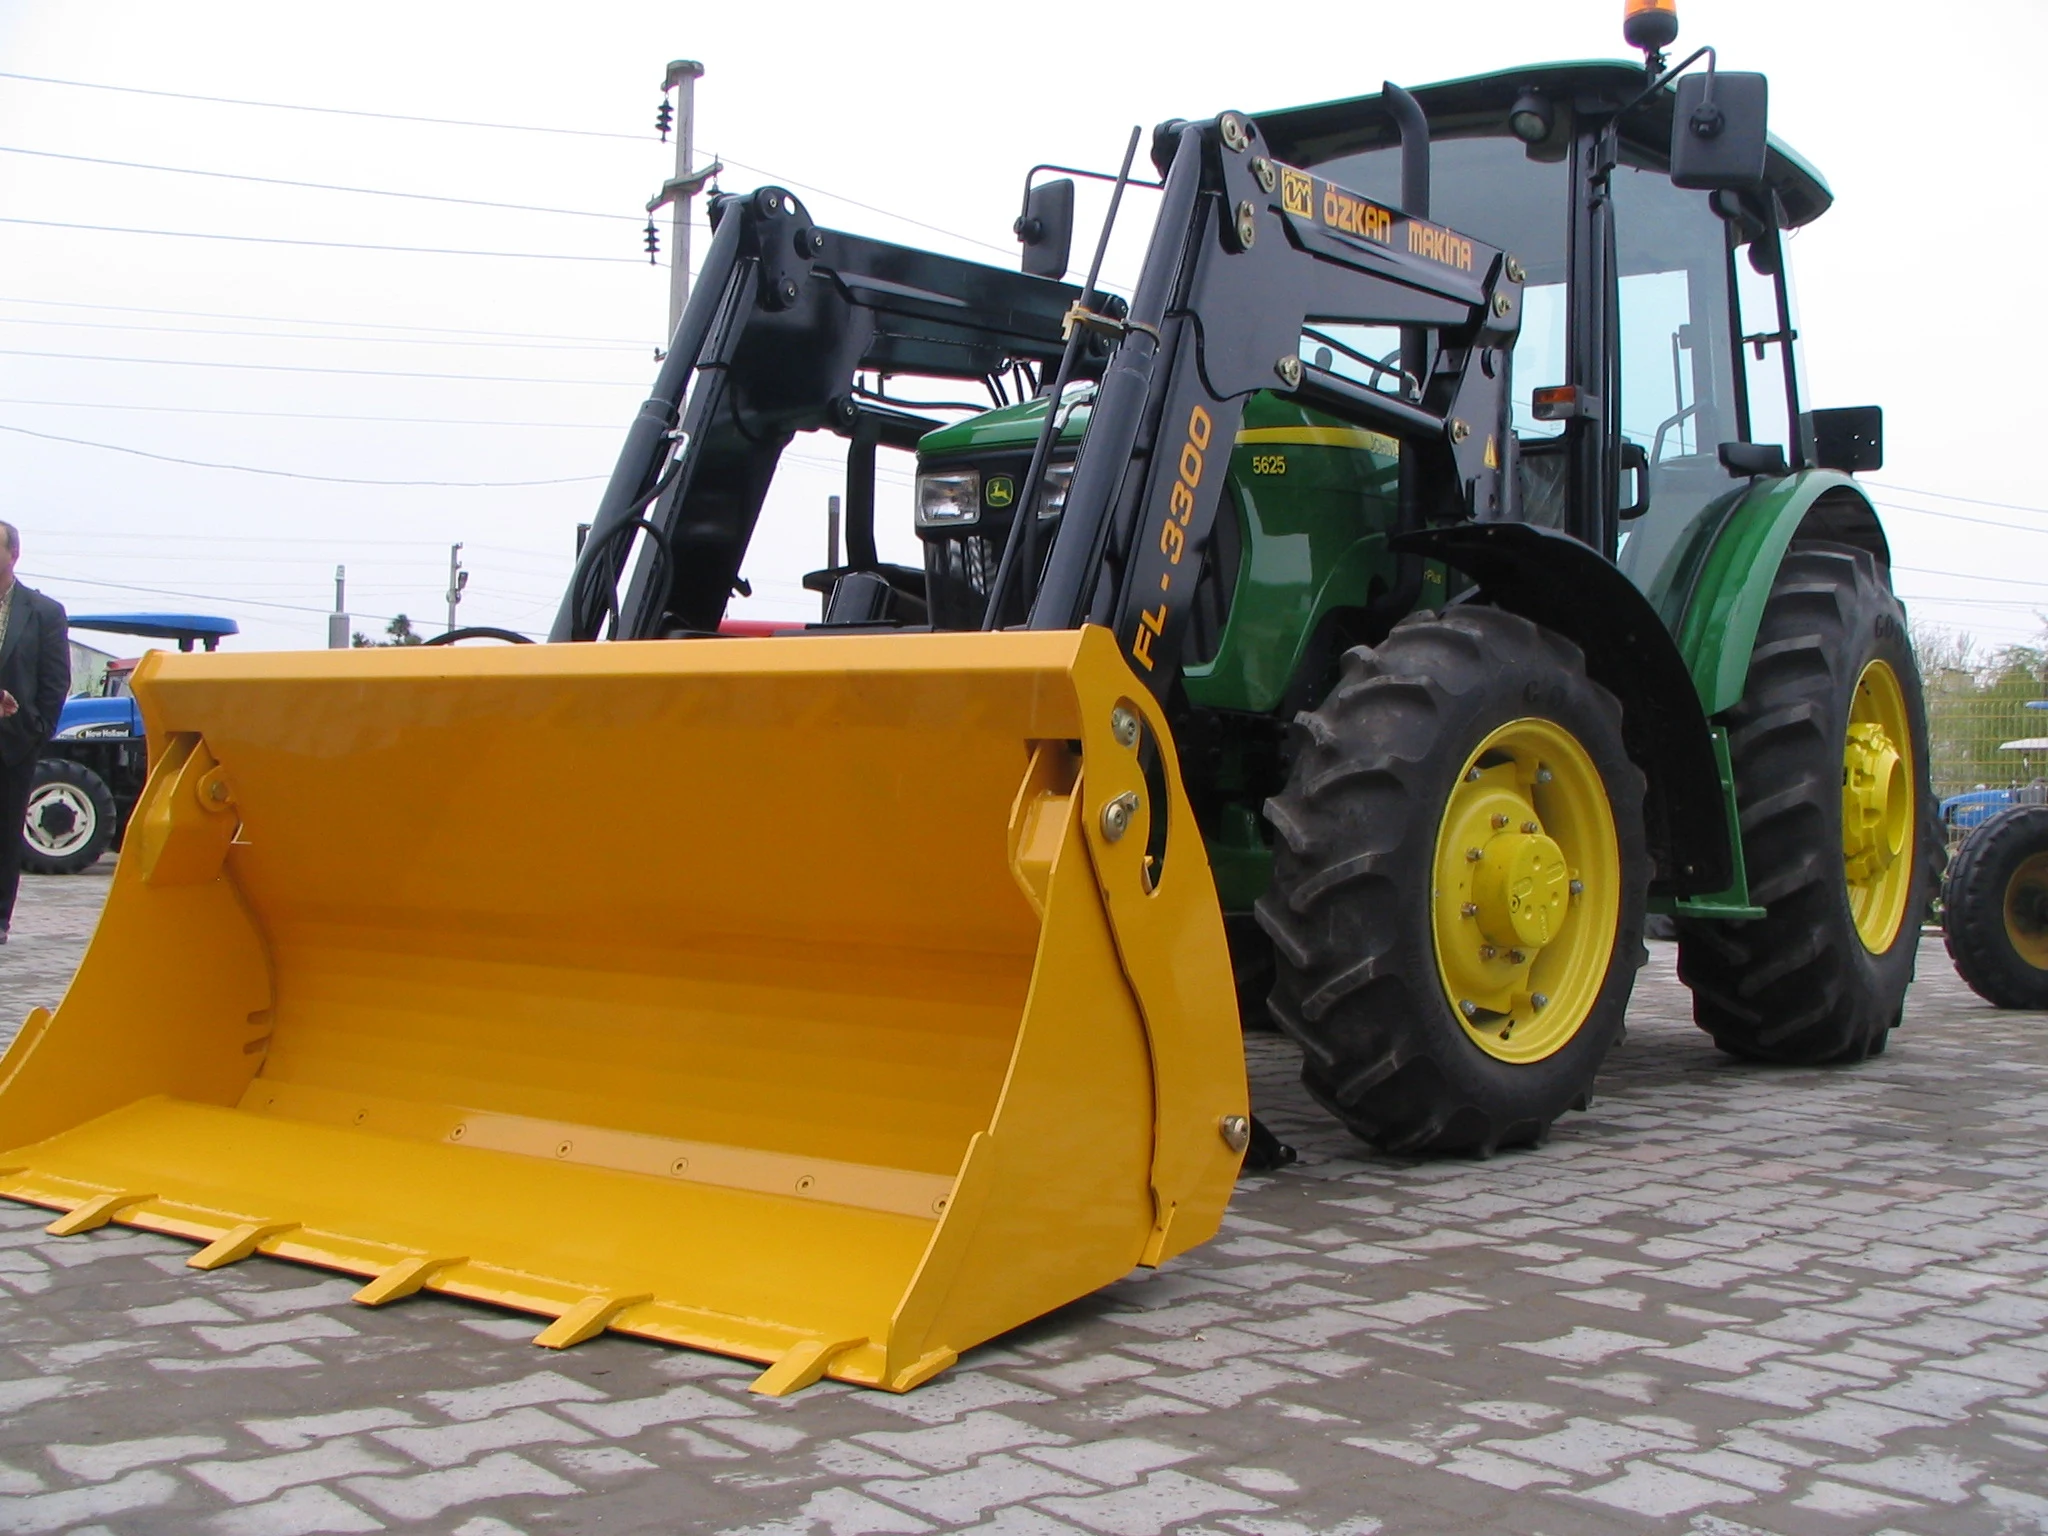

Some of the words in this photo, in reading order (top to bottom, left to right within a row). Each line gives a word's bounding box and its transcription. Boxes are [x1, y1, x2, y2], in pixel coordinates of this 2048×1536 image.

[1323, 184, 1391, 244] ÖZKAN
[1252, 455, 1286, 475] 5625
[1133, 604, 1167, 672] FL
[1160, 404, 1211, 565] 3300
